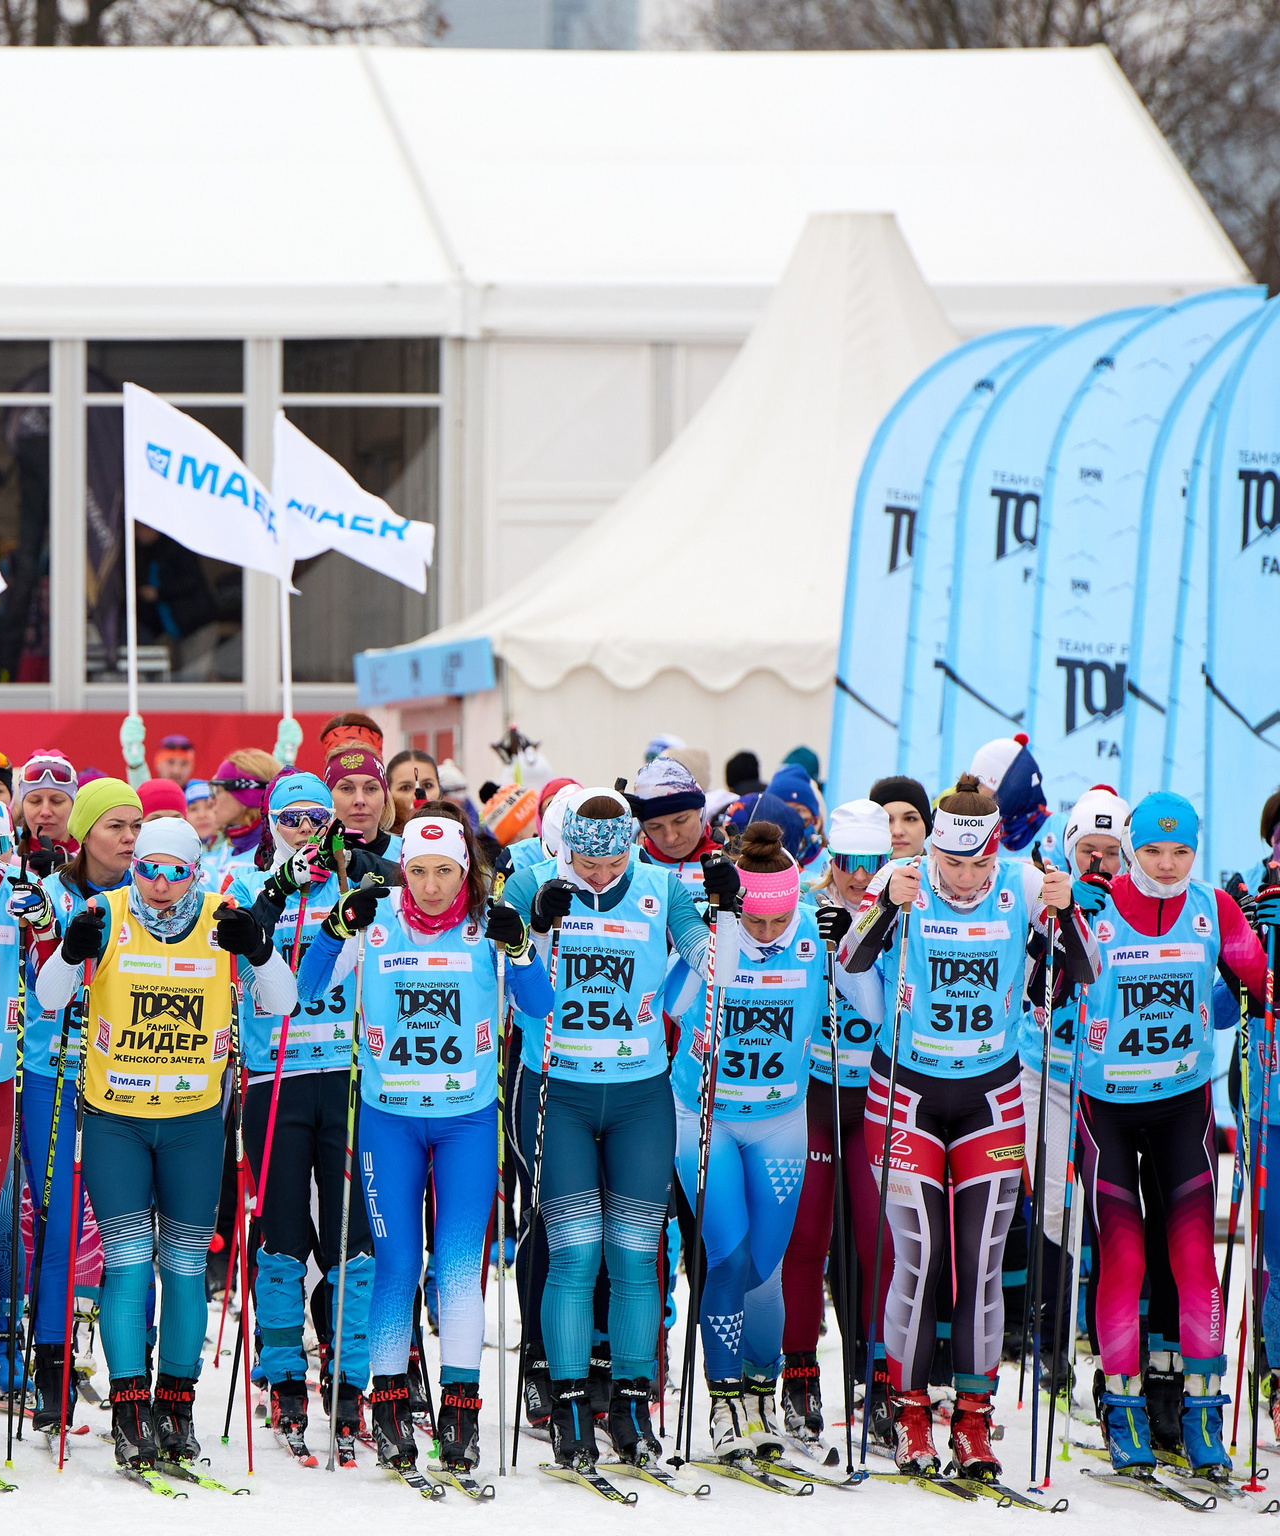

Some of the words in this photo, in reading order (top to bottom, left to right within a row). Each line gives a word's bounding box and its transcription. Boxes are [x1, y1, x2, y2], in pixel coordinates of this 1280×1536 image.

[1238, 450, 1267, 465] TEAM
[1058, 639, 1093, 655] TEAM
[953, 818, 975, 827] LUKOIL
[563, 921, 593, 930] MAER
[593, 947, 635, 956] PANZHINSKIY
[1117, 951, 1149, 960] MAER
[123, 960, 161, 969] greenworks
[561, 954, 635, 994] TOPSKI
[734, 975, 754, 984] AER
[929, 957, 998, 993] TOPSKI
[1149, 972, 1193, 980] PANZHINSKIY
[582, 986, 616, 995] FAMILY
[946, 990, 980, 998] FAMILY
[1118, 979, 1194, 1019] TOPSKI
[130, 991, 204, 1030] TOPSKI
[395, 989, 461, 1026] TOPSKI
[561, 1000, 633, 1031] 254
[930, 1003, 994, 1032] 318
[1140, 1011, 1174, 1020] FAMILY
[146, 1023, 179, 1032] FAMILY
[407, 1021, 440, 1030] FAMILY
[714, 987, 726, 1057] SWIX
[723, 1004, 793, 1042] TOPSKI
[116, 1031, 209, 1053] ЛИДЕР
[553, 1041, 592, 1052] greenworks
[739, 1038, 772, 1046] FAMILY
[914, 1039, 954, 1052] greenworks
[1118, 1024, 1194, 1057] 454
[389, 1036, 462, 1066] 456
[113, 1054, 167, 1064] ЖЕНСКОГО
[170, 1056, 205, 1064] ЗАЧЕТА
[721, 1048, 784, 1080] 316
[1109, 1068, 1151, 1076] greenworks
[119, 1078, 151, 1087] MAER
[363, 1151, 387, 1239] SPINE
[1210, 1287, 1220, 1342] WINDSKI
[560, 1390, 585, 1399] alpina
